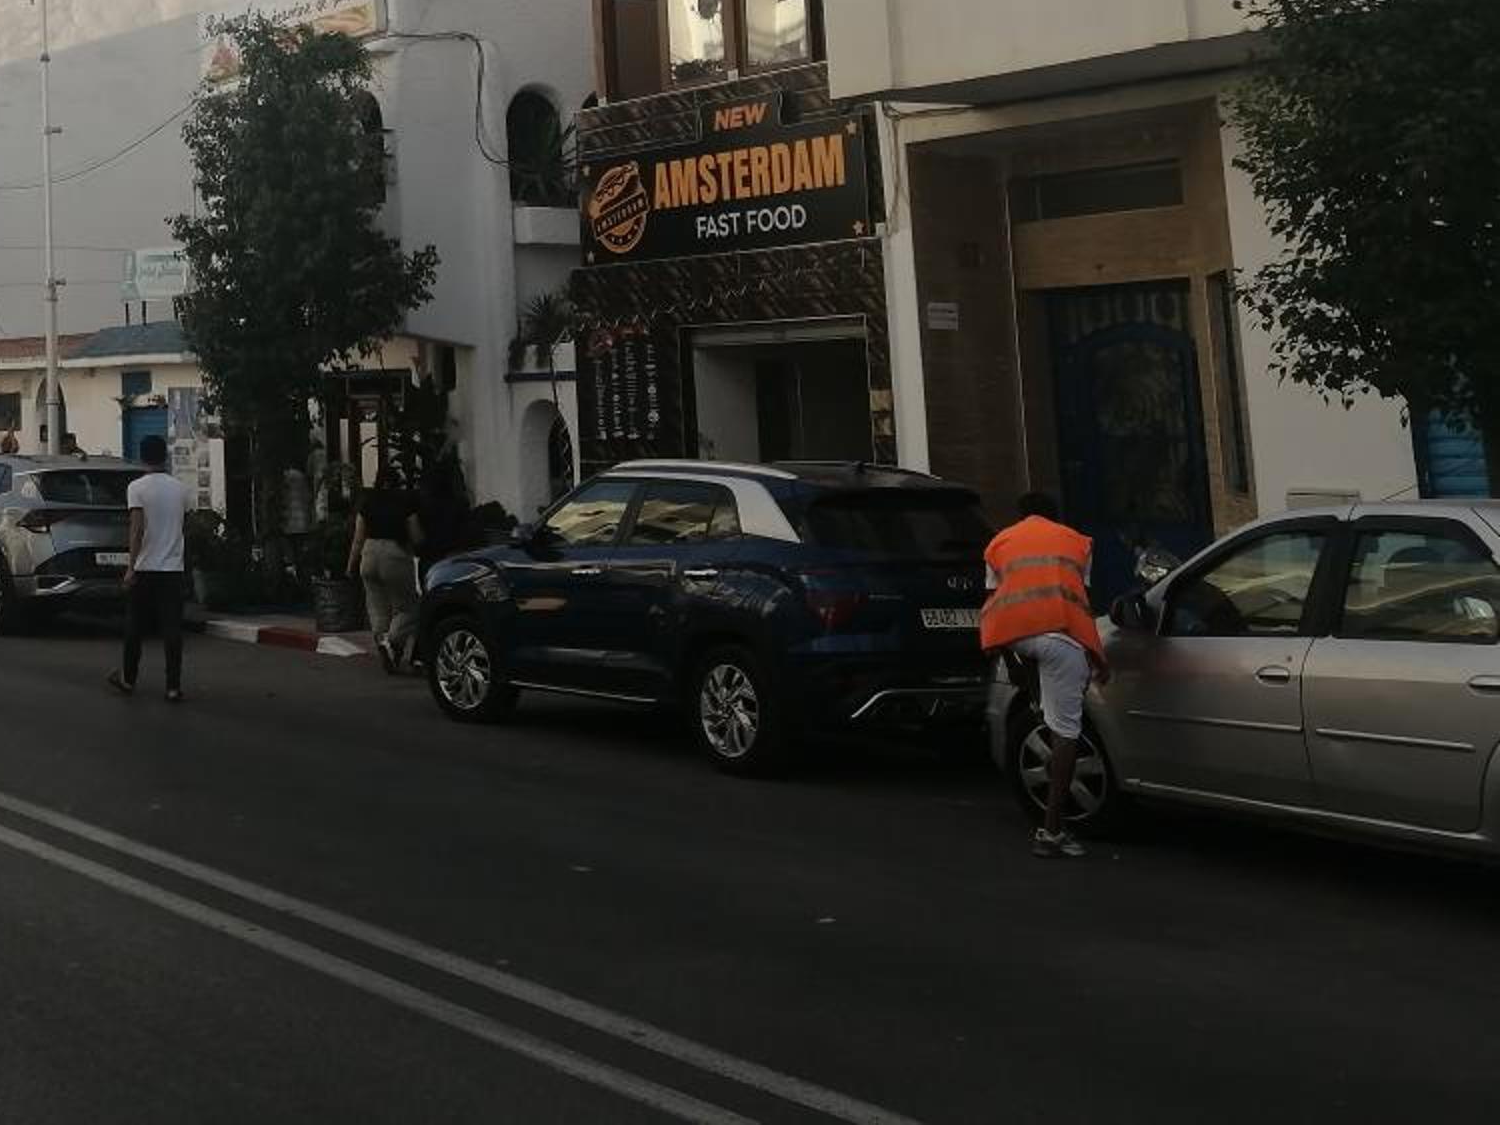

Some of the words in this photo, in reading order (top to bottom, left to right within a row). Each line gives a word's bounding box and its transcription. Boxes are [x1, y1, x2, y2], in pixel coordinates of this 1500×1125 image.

[715, 103, 766, 131] NEW
[654, 133, 846, 210] AMSTERDAM
[696, 212, 741, 239] FAST
[746, 204, 807, 234] FOOD
